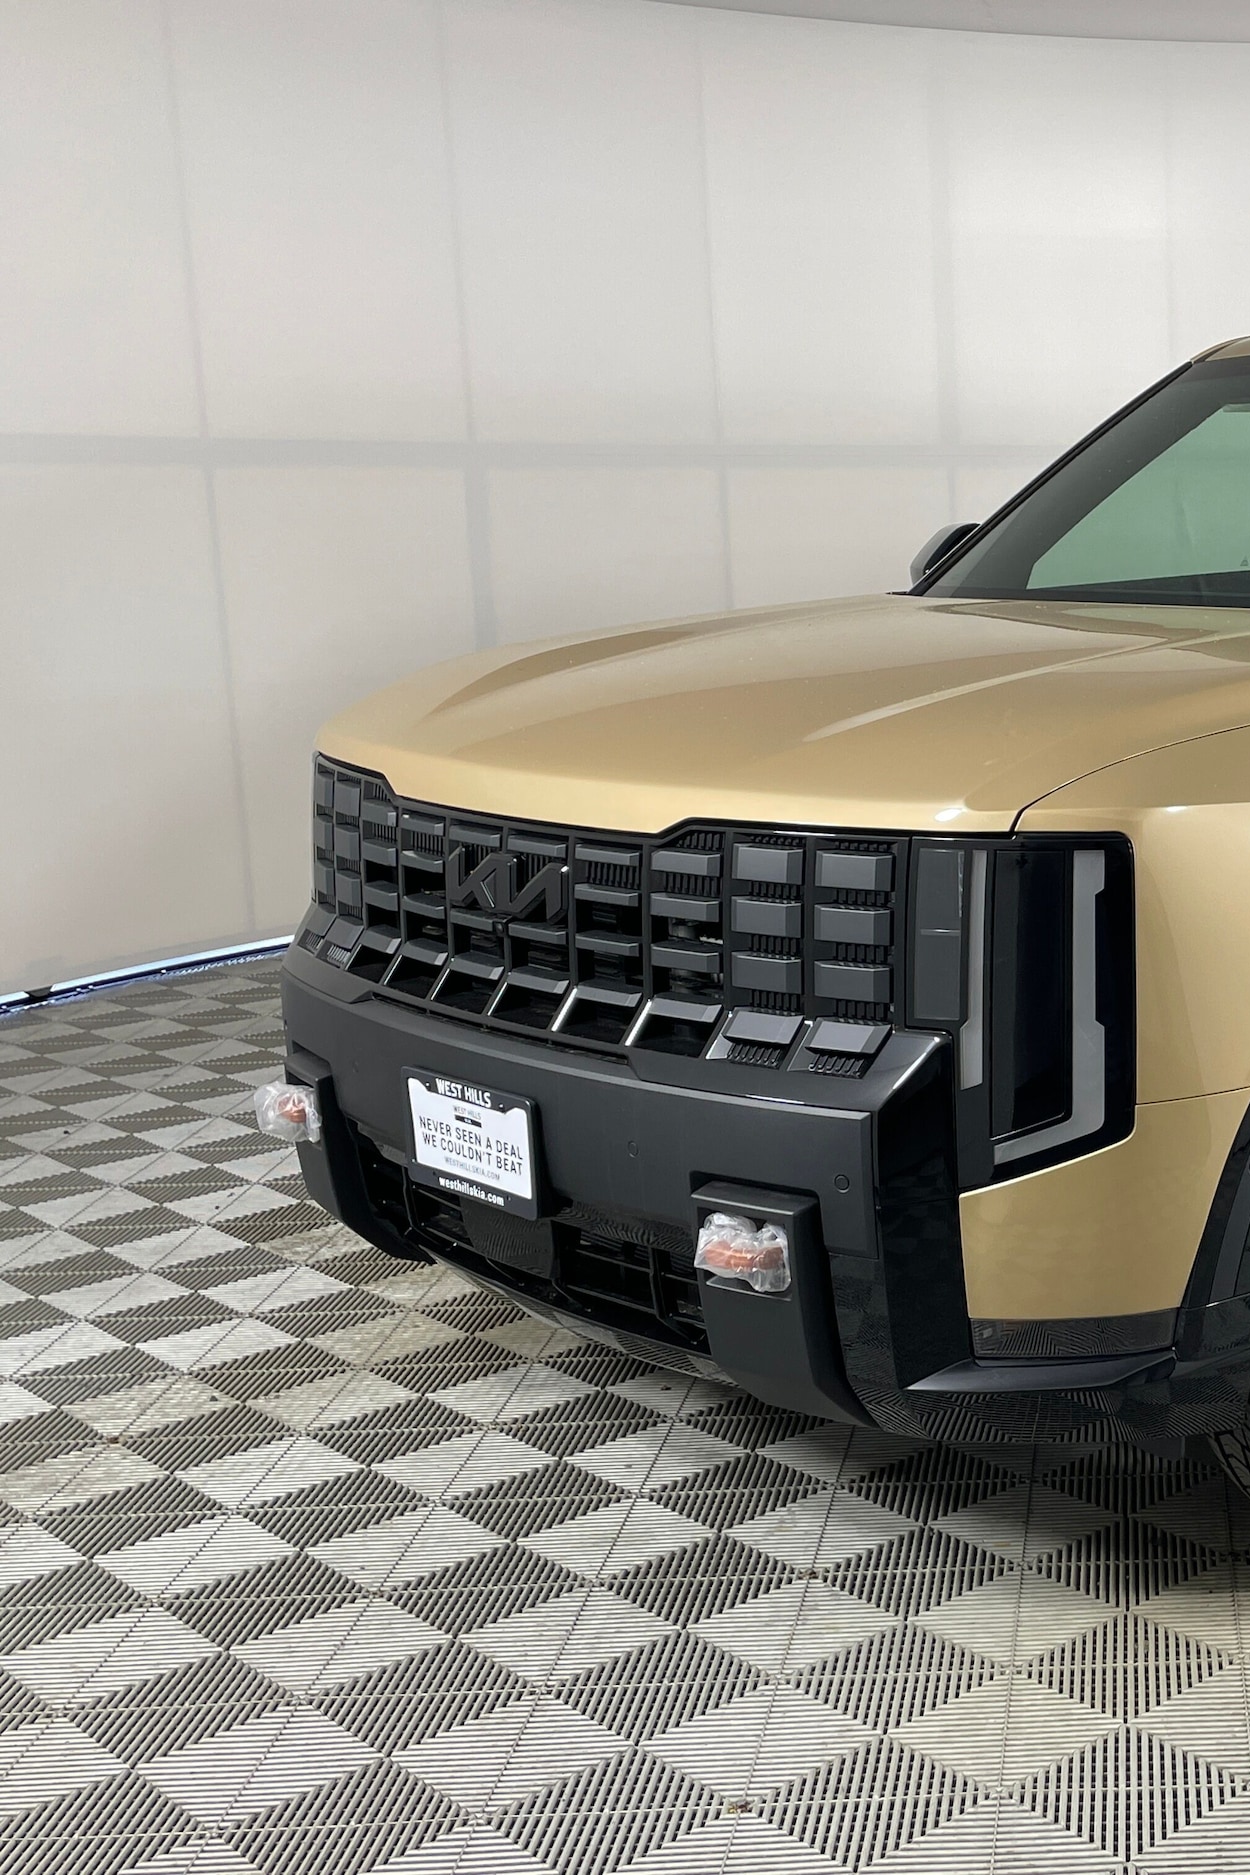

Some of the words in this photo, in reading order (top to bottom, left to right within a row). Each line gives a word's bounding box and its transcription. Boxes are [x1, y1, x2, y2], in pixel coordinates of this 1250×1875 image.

[435, 1078, 462, 1099] WEST
[464, 1086, 491, 1108] HILLS
[419, 1116, 452, 1137] NEVER
[455, 1127, 482, 1147] SEEN
[486, 1137, 492, 1151] A
[496, 1140, 523, 1160] DEAL
[422, 1131, 437, 1148] WE
[441, 1138, 492, 1166] COULDN'T
[496, 1156, 523, 1176] BEAT
[444, 1156, 500, 1180] WESTHILLSKIA.COM
[438, 1177, 505, 1207] westhillskia.com
